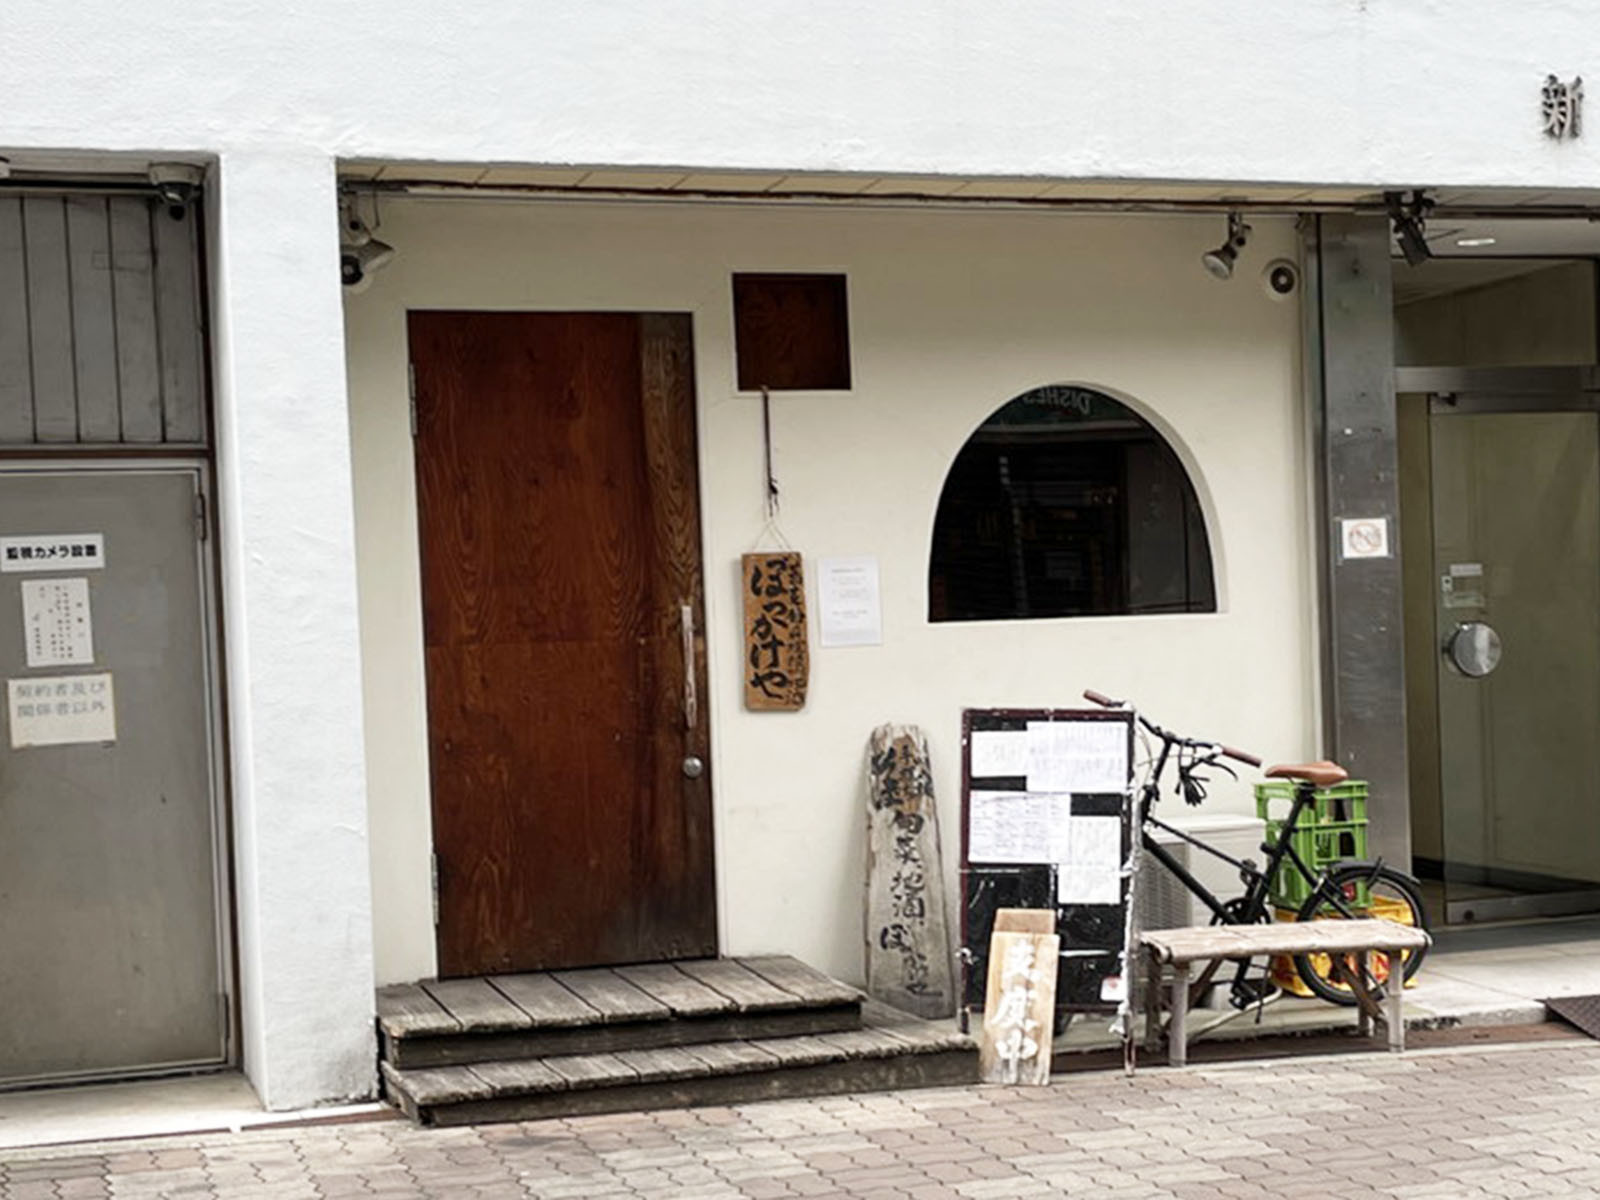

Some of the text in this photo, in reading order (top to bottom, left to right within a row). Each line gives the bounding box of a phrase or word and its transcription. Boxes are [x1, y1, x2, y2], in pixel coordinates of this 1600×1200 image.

[1542, 74, 1584, 142] 新
[6, 544, 97, 560] 監視カメラ設置
